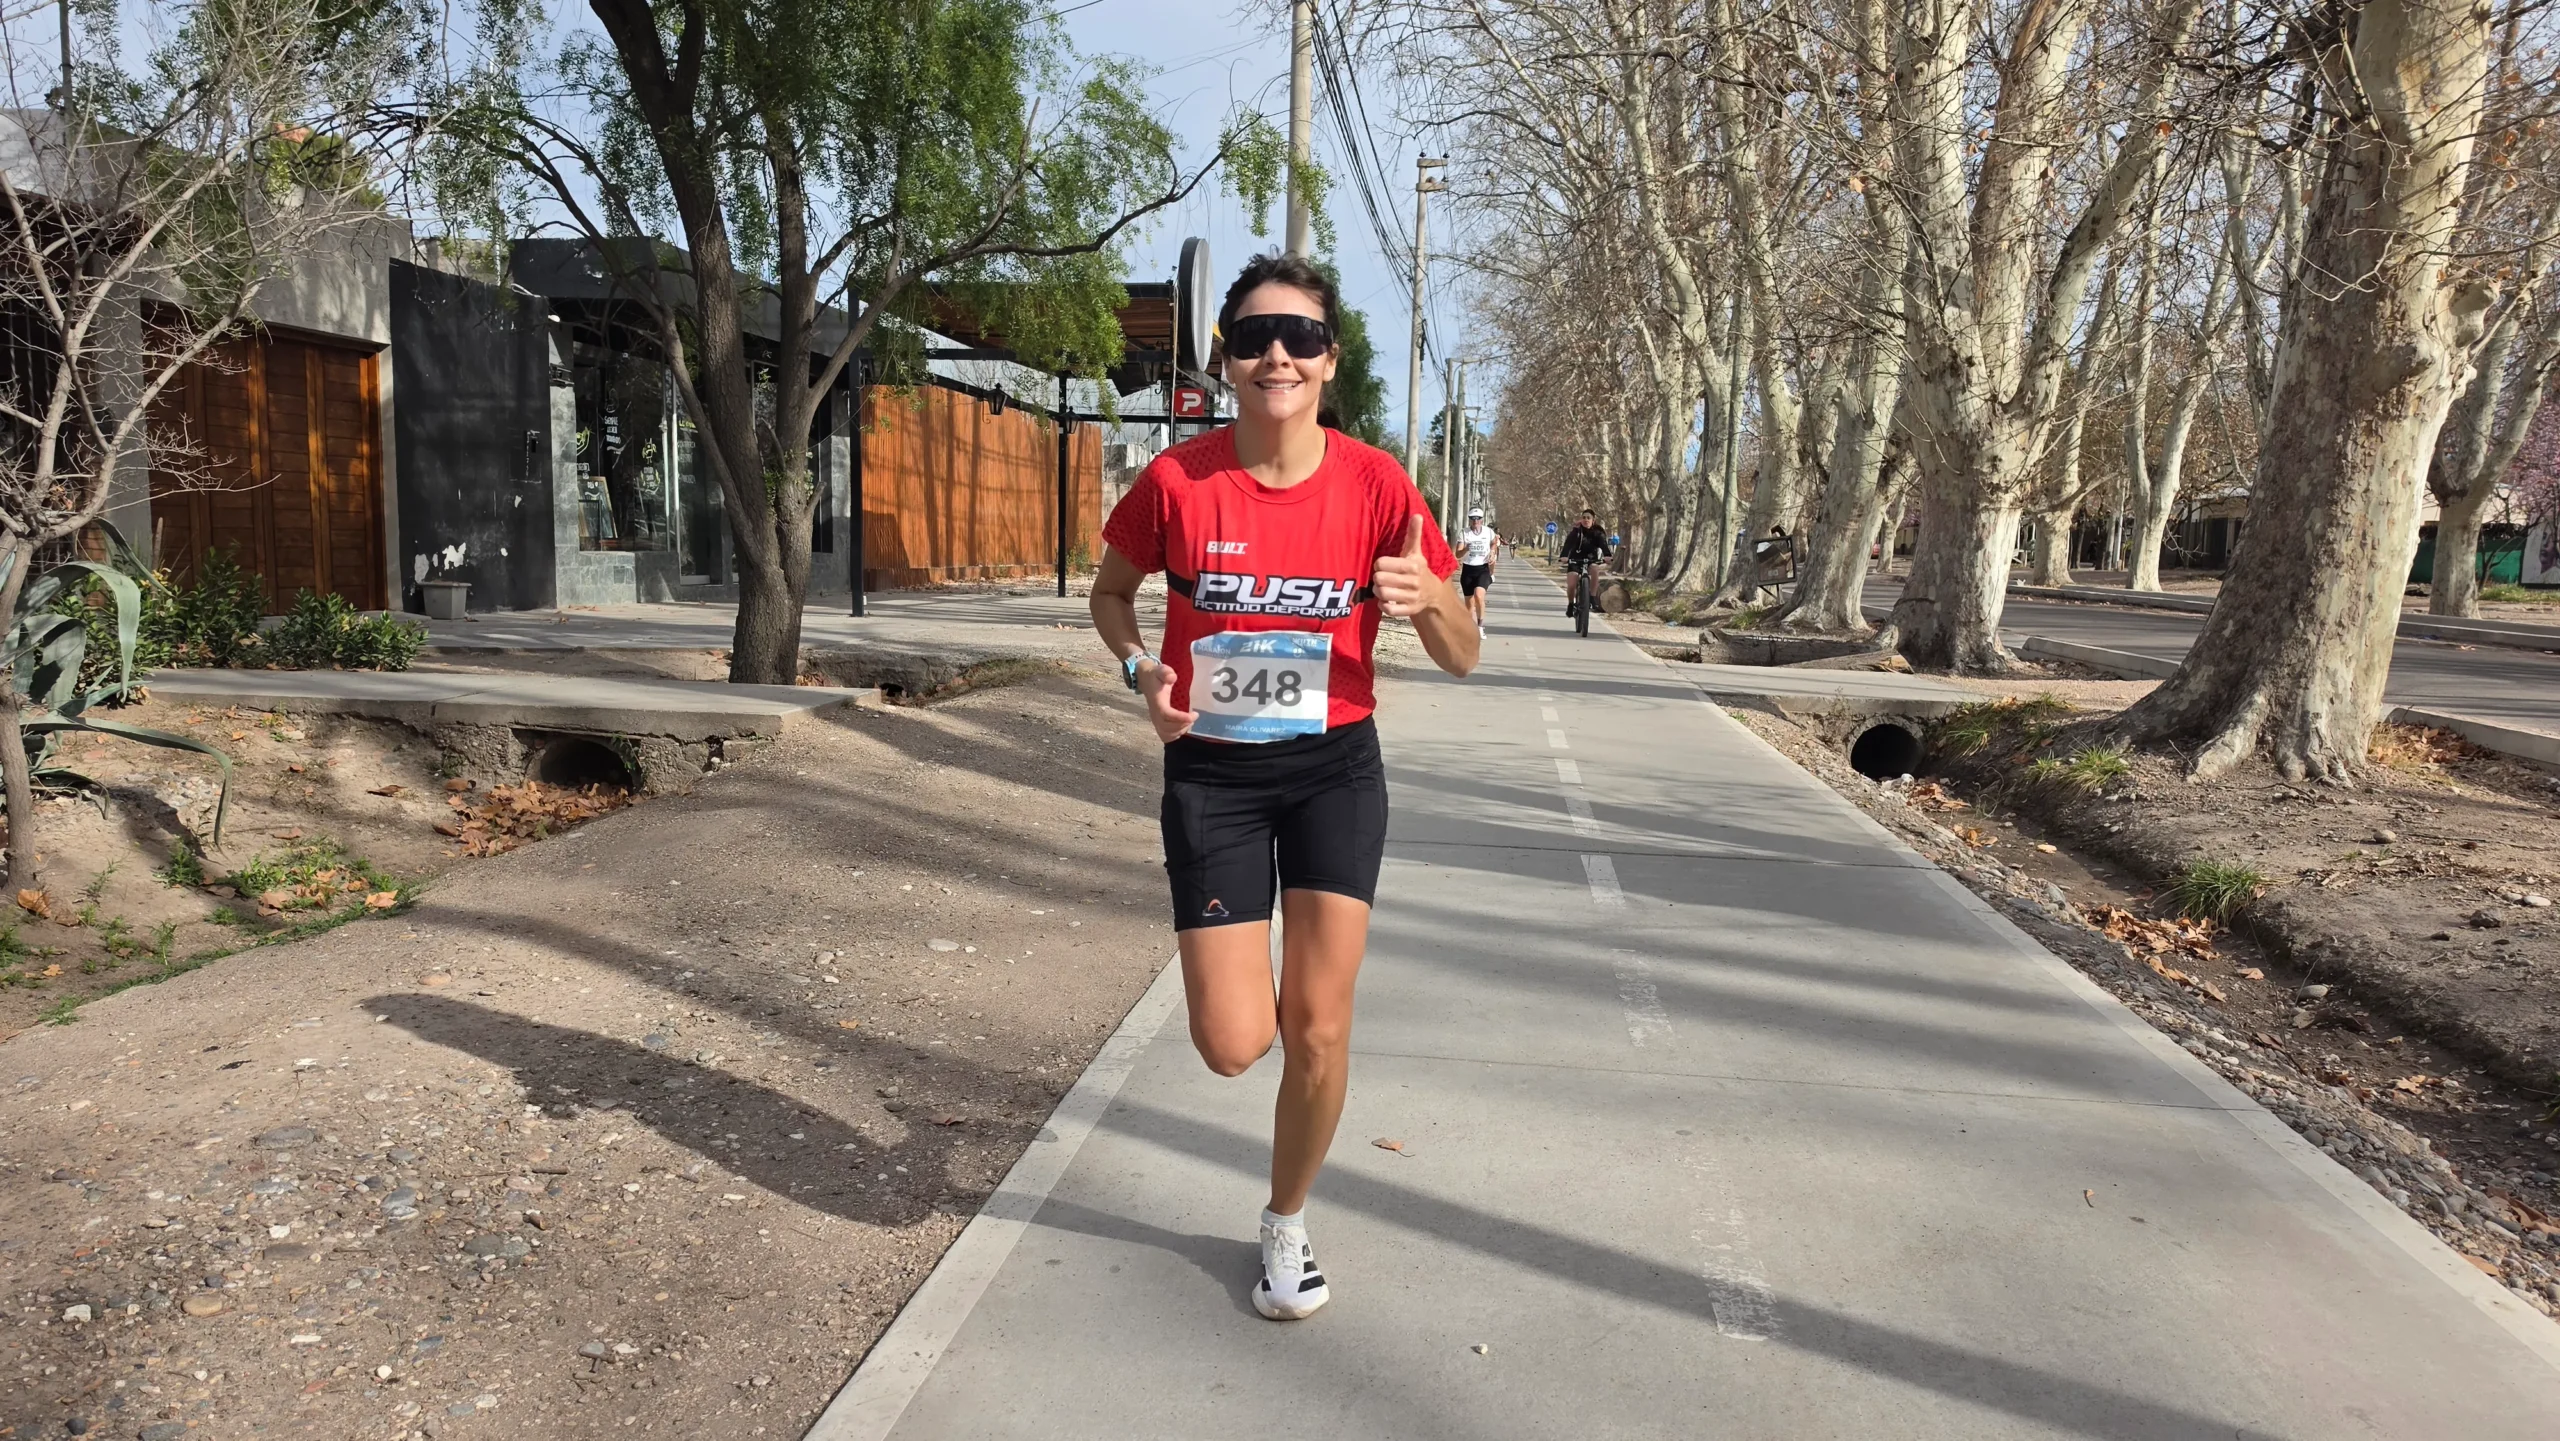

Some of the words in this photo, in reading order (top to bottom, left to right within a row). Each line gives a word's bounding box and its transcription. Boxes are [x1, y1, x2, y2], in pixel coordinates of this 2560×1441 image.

[1182, 393, 1202, 411] P
[1195, 572, 1355, 608] PUSH
[1194, 600, 1260, 612] ACTITUD
[1265, 604, 1351, 618] DEPORTIVA
[1211, 667, 1302, 707] 348
[1225, 724, 1248, 732] MAIRA
[1249, 725, 1286, 733] OLIVAREZ
